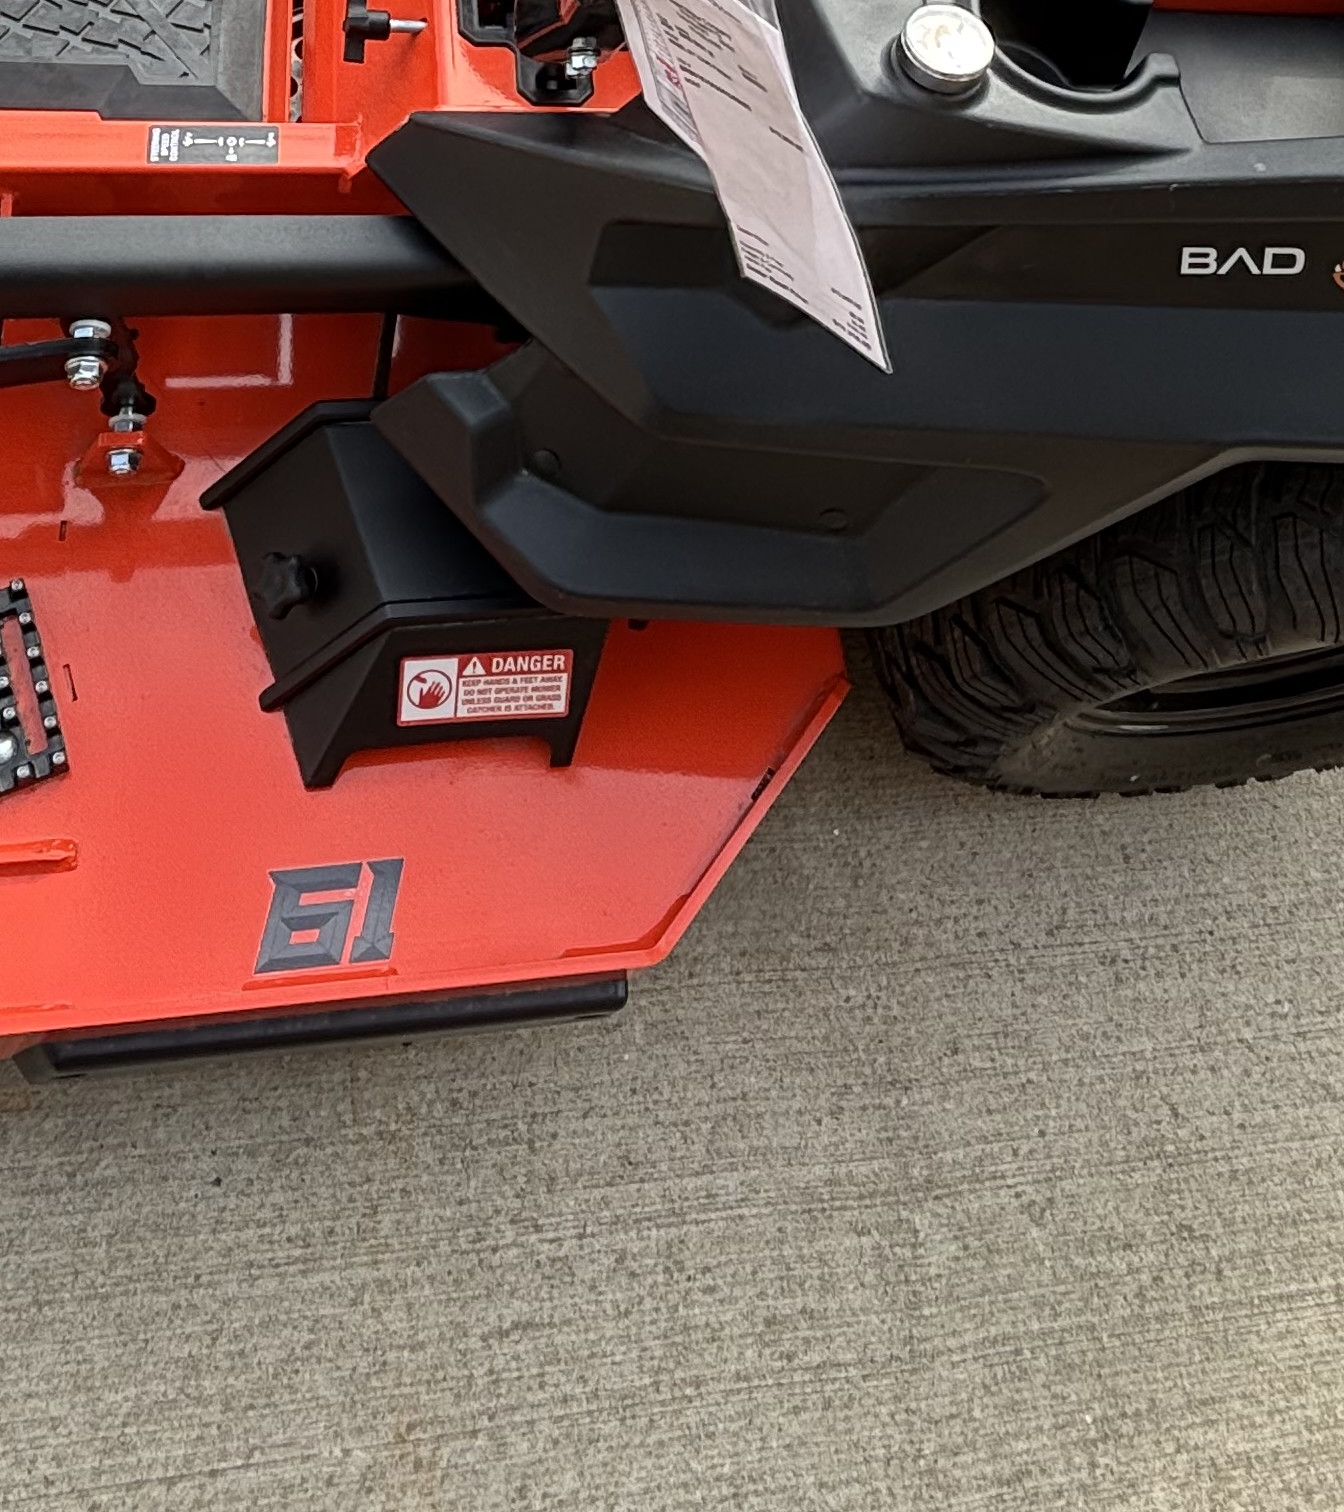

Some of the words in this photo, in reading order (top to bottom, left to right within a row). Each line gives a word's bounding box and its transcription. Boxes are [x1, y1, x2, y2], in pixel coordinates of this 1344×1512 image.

[1179, 246, 1306, 275] BAD
[491, 655, 565, 673] DANGER
[462, 679, 481, 687] KEEP
[483, 678, 510, 686] HANDS
[520, 676, 539, 685] FEET
[464, 689, 475, 697] DO
[477, 688, 493, 696] NOT
[494, 686, 529, 695] OPERATE
[462, 697, 492, 706] UNLESS
[494, 696, 521, 704] GUARD
[523, 695, 534, 703] OR
[535, 694, 562, 702] GRASS
[467, 705, 502, 714] CATCHER
[504, 704, 512, 713] IS
[253, 857, 404, 975] 61
